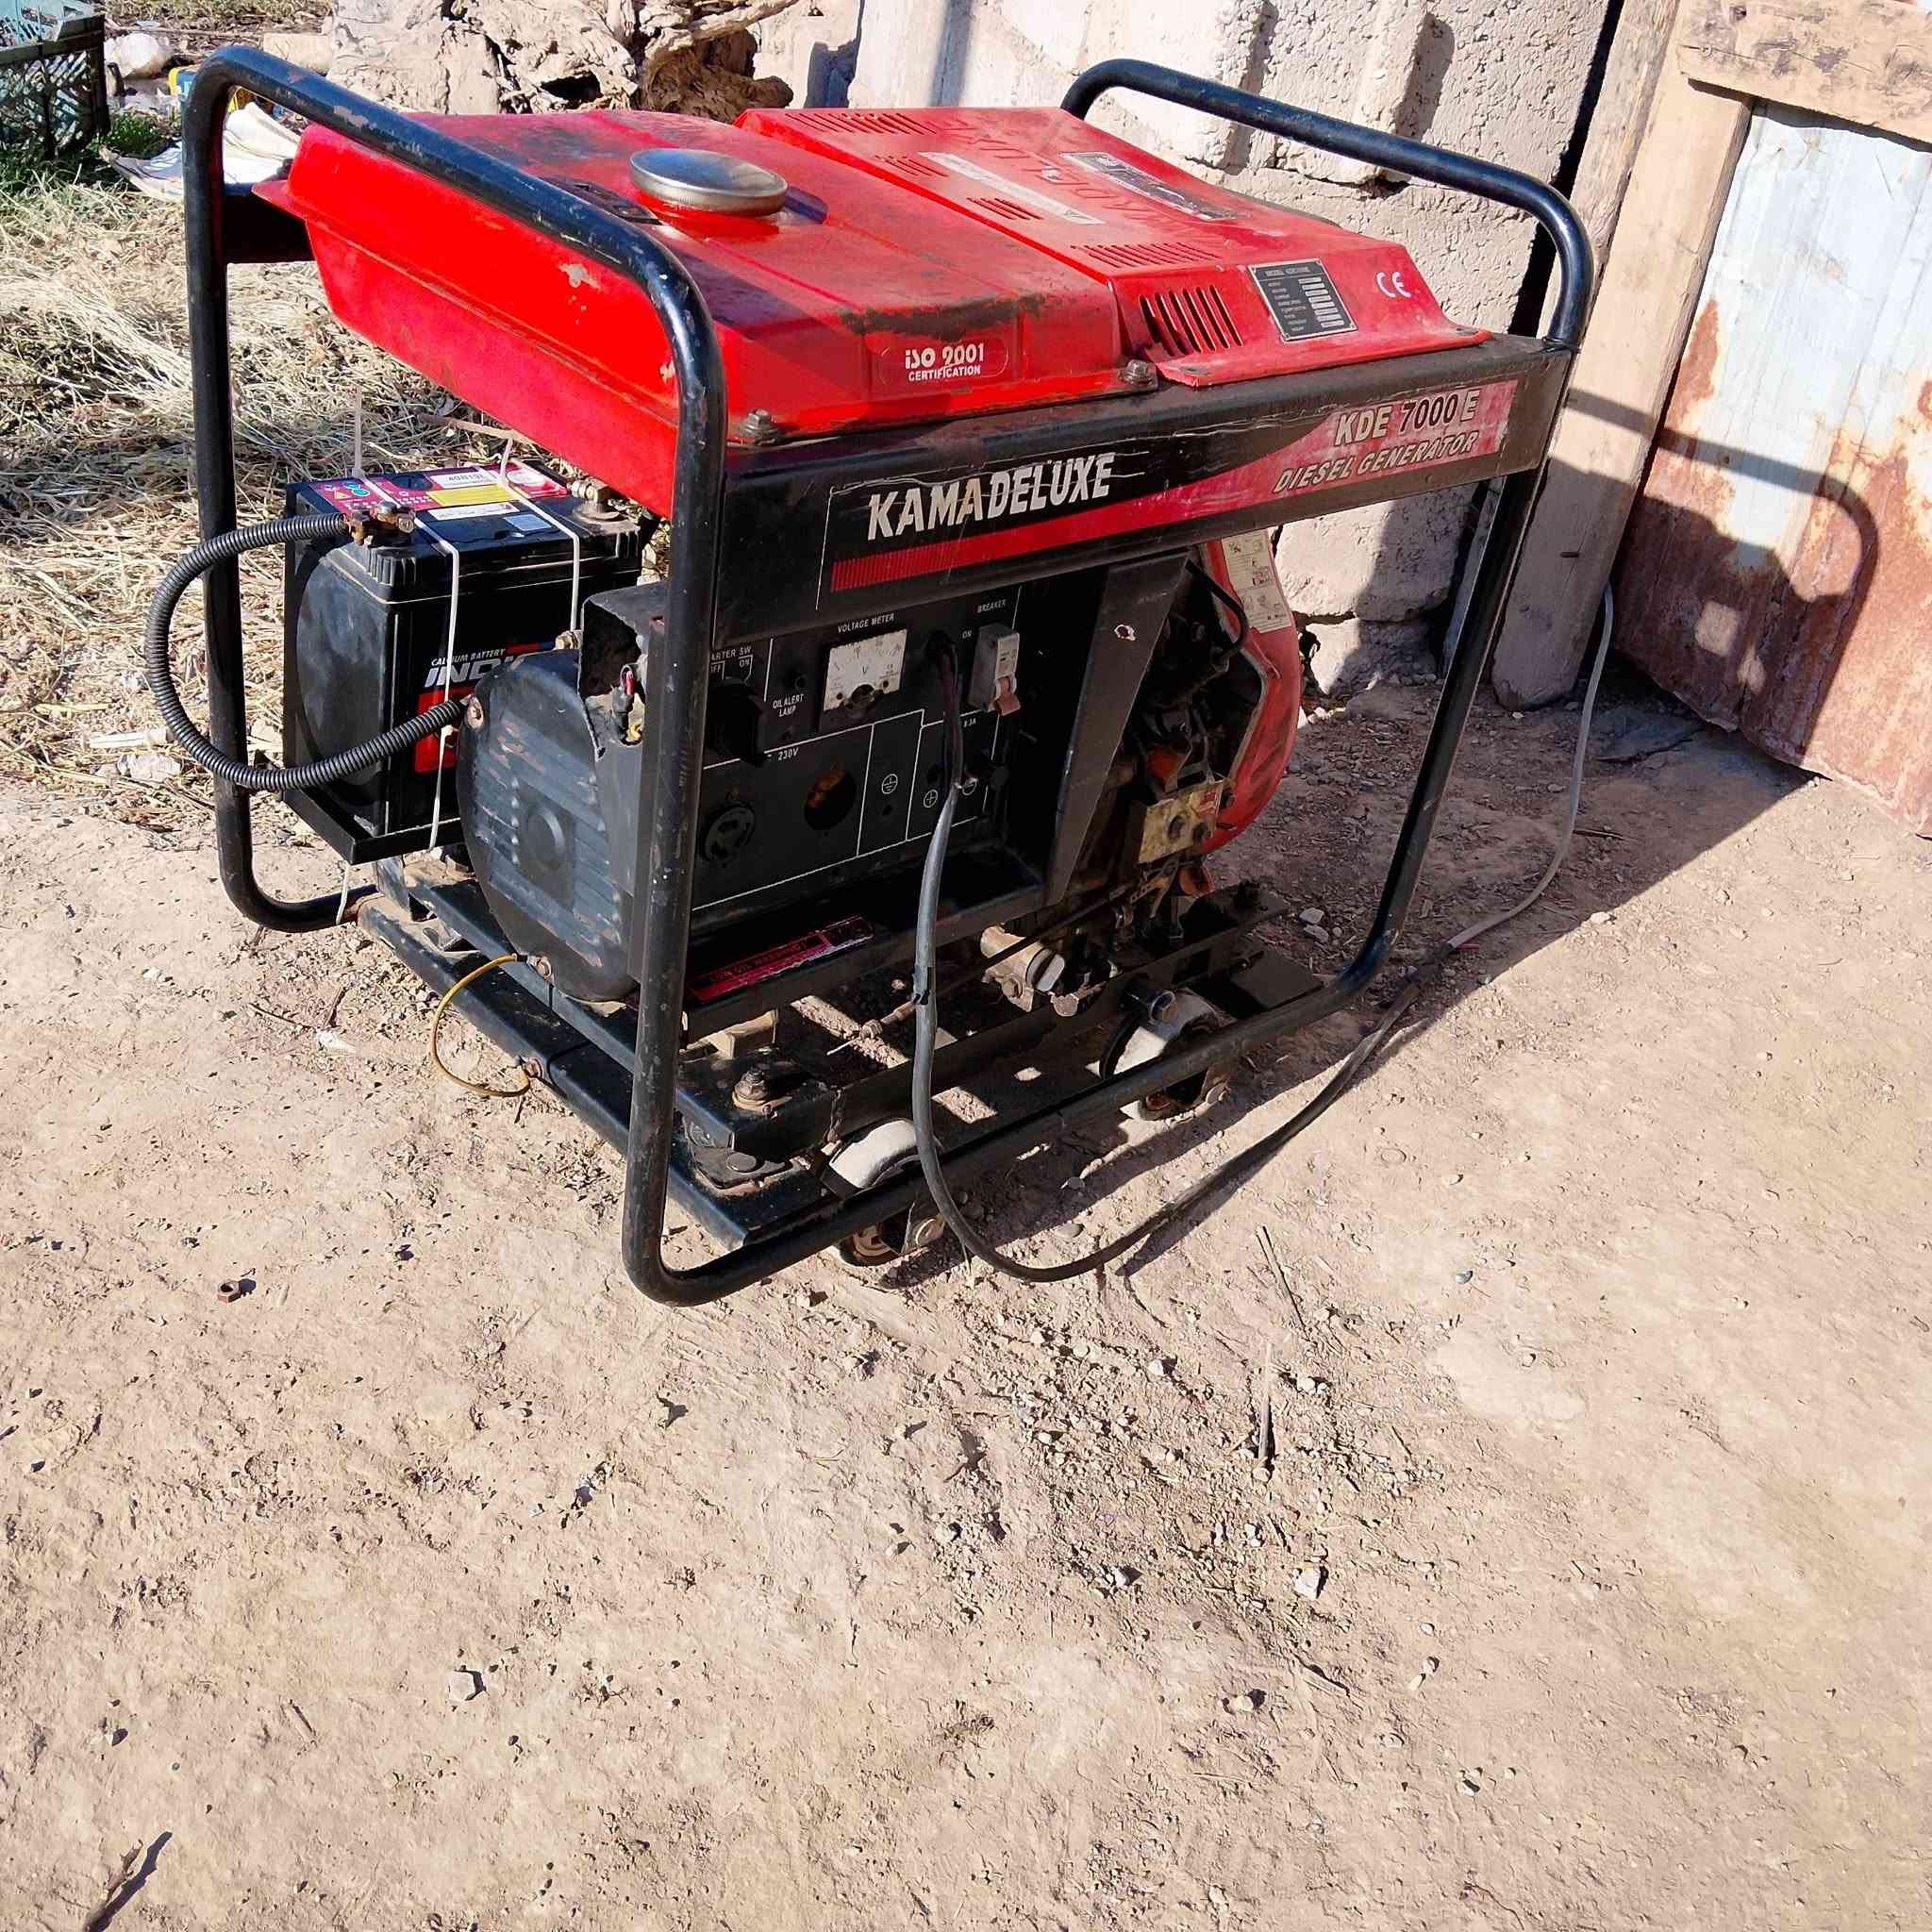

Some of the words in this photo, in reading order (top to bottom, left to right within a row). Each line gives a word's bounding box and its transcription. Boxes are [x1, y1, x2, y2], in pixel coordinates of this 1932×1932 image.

[1376, 272, 1411, 297] CE
[908, 365, 981, 381] CERTIFICATION
[1333, 404, 1393, 446] KDE
[1399, 393, 1459, 432] 7000
[1459, 388, 1481, 422] E
[1273, 456, 1357, 494] DIESEL
[1357, 429, 1480, 474] GENERATOR
[976, 599, 1007, 613] BREAKER
[838, 620, 869, 633] VOLTAGE
[871, 612, 895, 625] METER
[431, 655, 469, 666] CALIUM
[470, 648, 506, 661] BATTERY
[710, 649, 736, 661] ARTER
[739, 645, 752, 656] SW
[739, 658, 750, 668] ON
[773, 698, 783, 709] OIL
[784, 693, 804, 707] ALERT
[779, 706, 797, 717] LAMP
[778, 747, 799, 761] 230V
